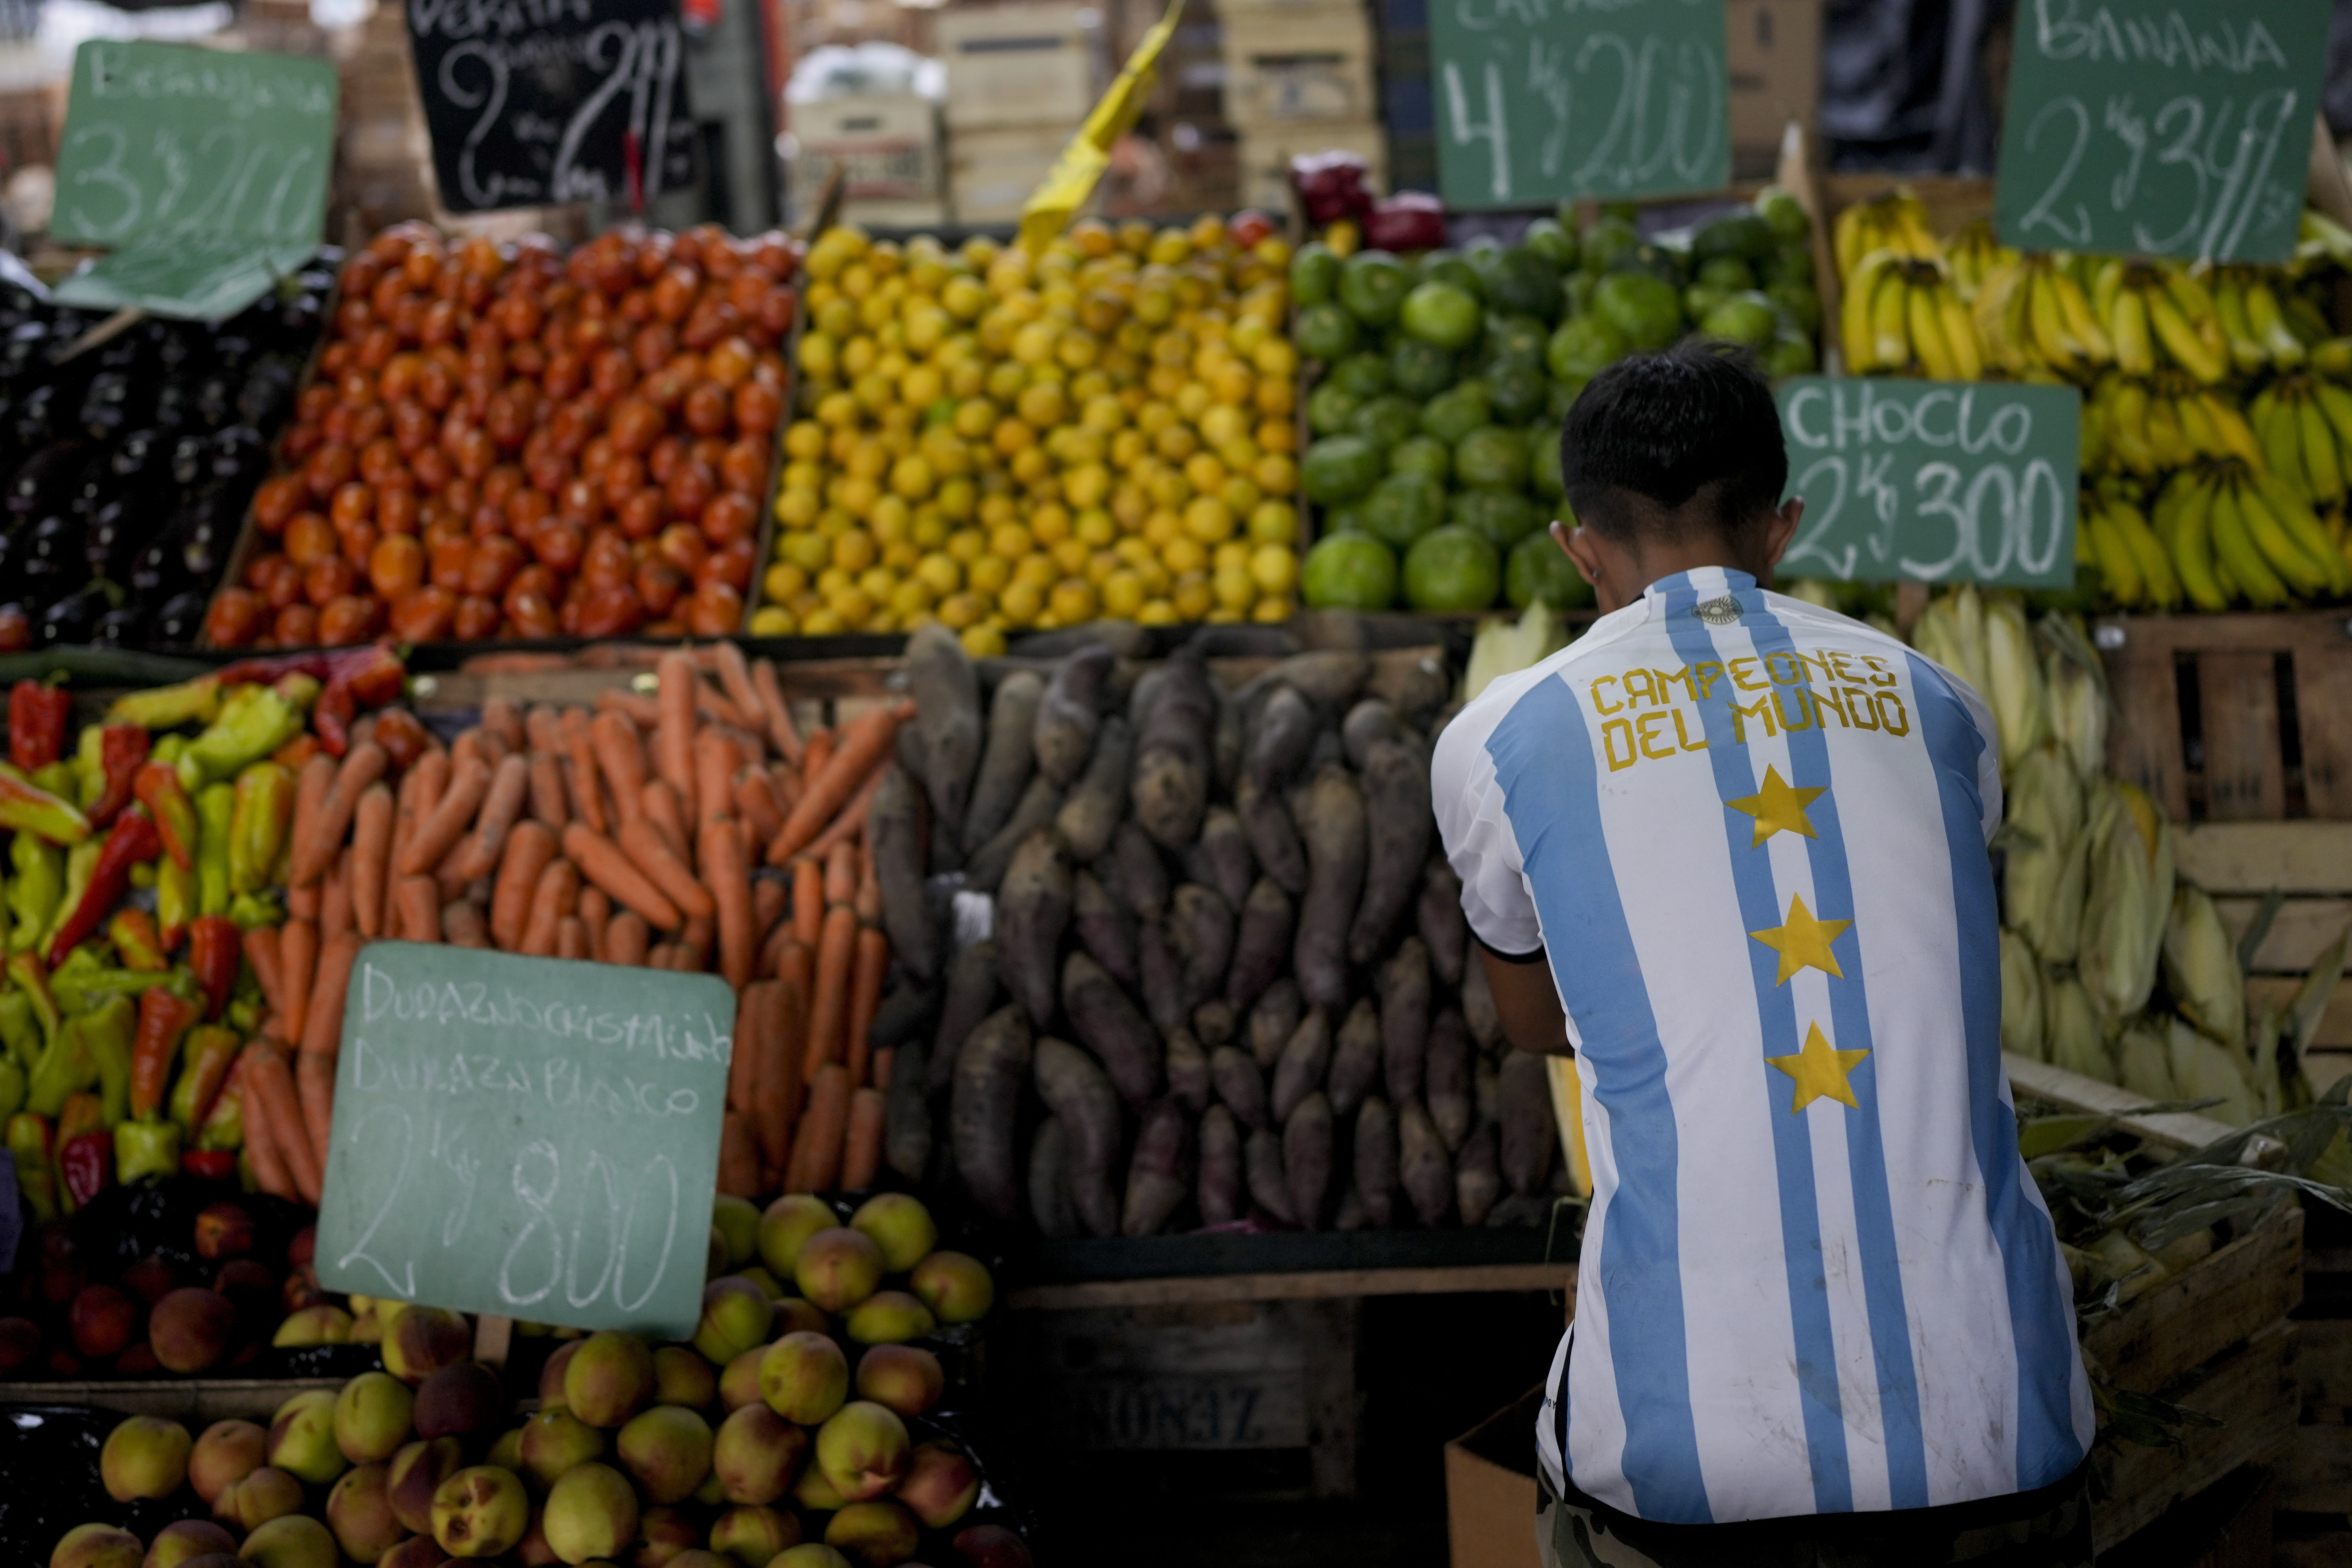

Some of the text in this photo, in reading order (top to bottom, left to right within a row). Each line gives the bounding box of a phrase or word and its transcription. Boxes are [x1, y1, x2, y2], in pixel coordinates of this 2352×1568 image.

[69, 119, 143, 240] 3
[1441, 59, 1513, 204] 4
[2019, 94, 2093, 245] 2
[1788, 381, 2032, 456] CHOCLO
[1786, 455, 1857, 580] 2
[1900, 457, 2064, 580] 300
[1590, 650, 1897, 716] CAMPEONES
[1601, 686, 1910, 772] DEL MUNDO
[338, 1103, 416, 1298] 2
[499, 1138, 678, 1312] 800
